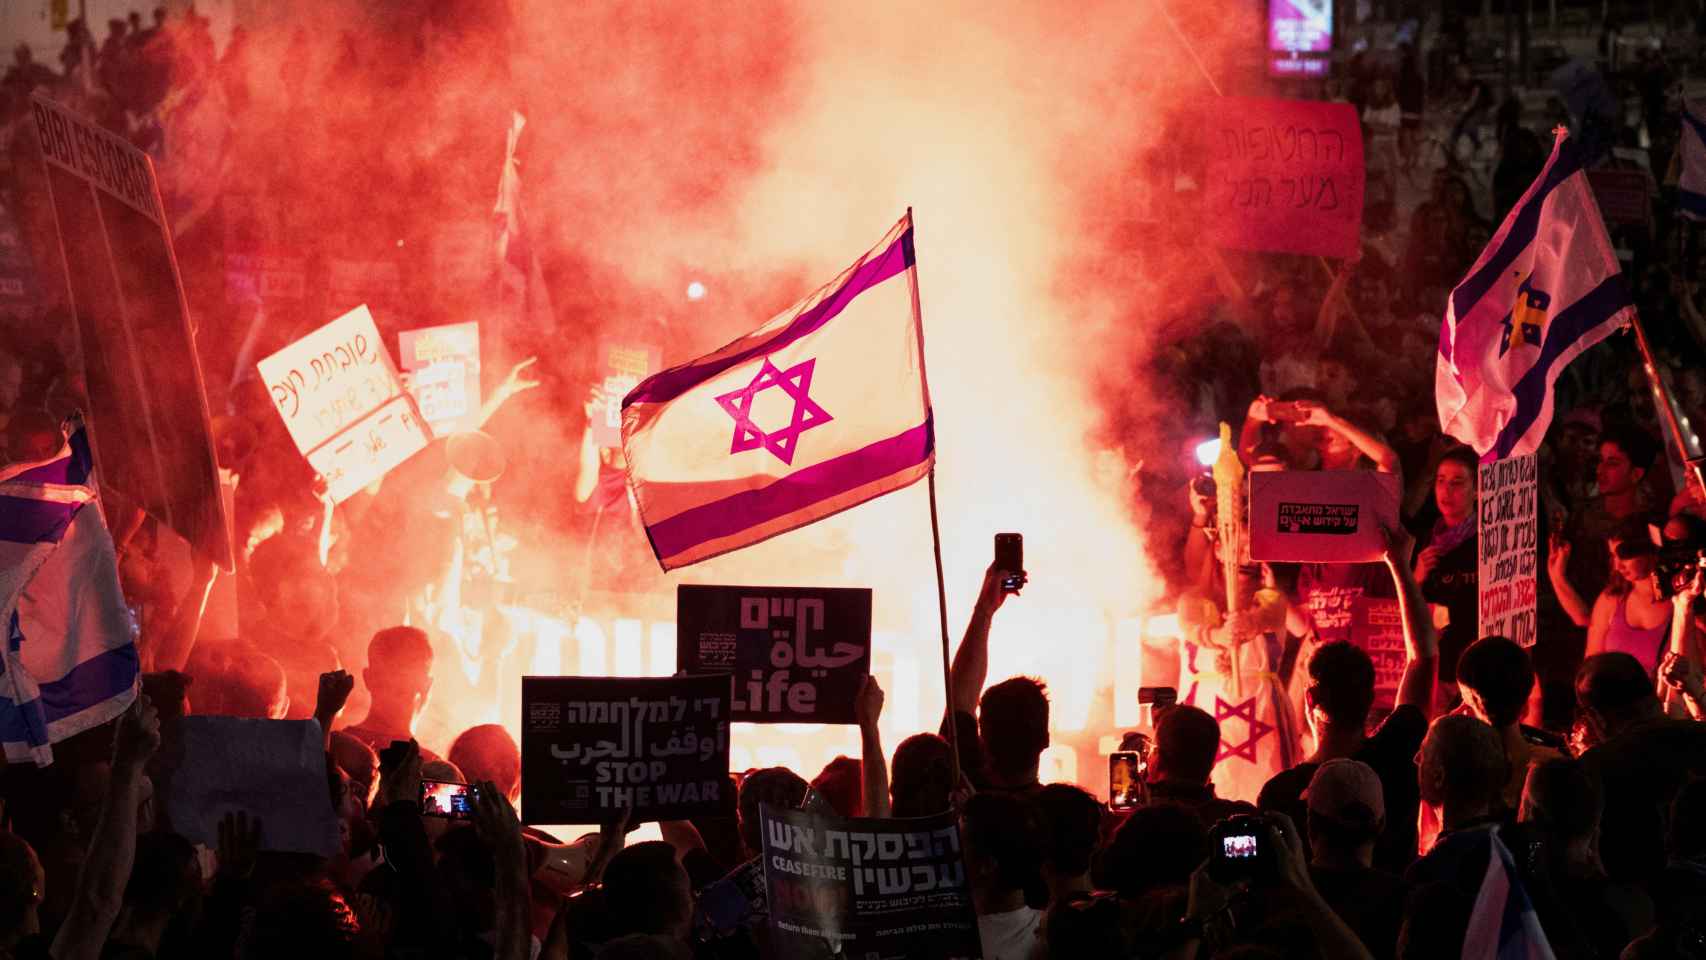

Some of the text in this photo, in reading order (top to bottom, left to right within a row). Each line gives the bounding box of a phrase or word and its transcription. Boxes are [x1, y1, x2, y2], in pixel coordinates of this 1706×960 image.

[32, 101, 76, 168] BIBI
[271, 368, 305, 419] רעב
[1280, 504, 1356, 516] ישראל מתאבדת
[1343, 516, 1357, 527] על
[740, 597, 825, 630] חיים
[770, 628, 866, 678] حياة
[731, 670, 817, 713] Life
[567, 696, 688, 724] למלחמה
[693, 697, 721, 720] די
[595, 761, 667, 784] STOP
[595, 786, 650, 808] THE
[655, 782, 721, 804] WAR
[768, 819, 961, 866] הפסקת אש
[771, 855, 847, 881] CEASEFIRE
[852, 863, 965, 895] עכשיו
